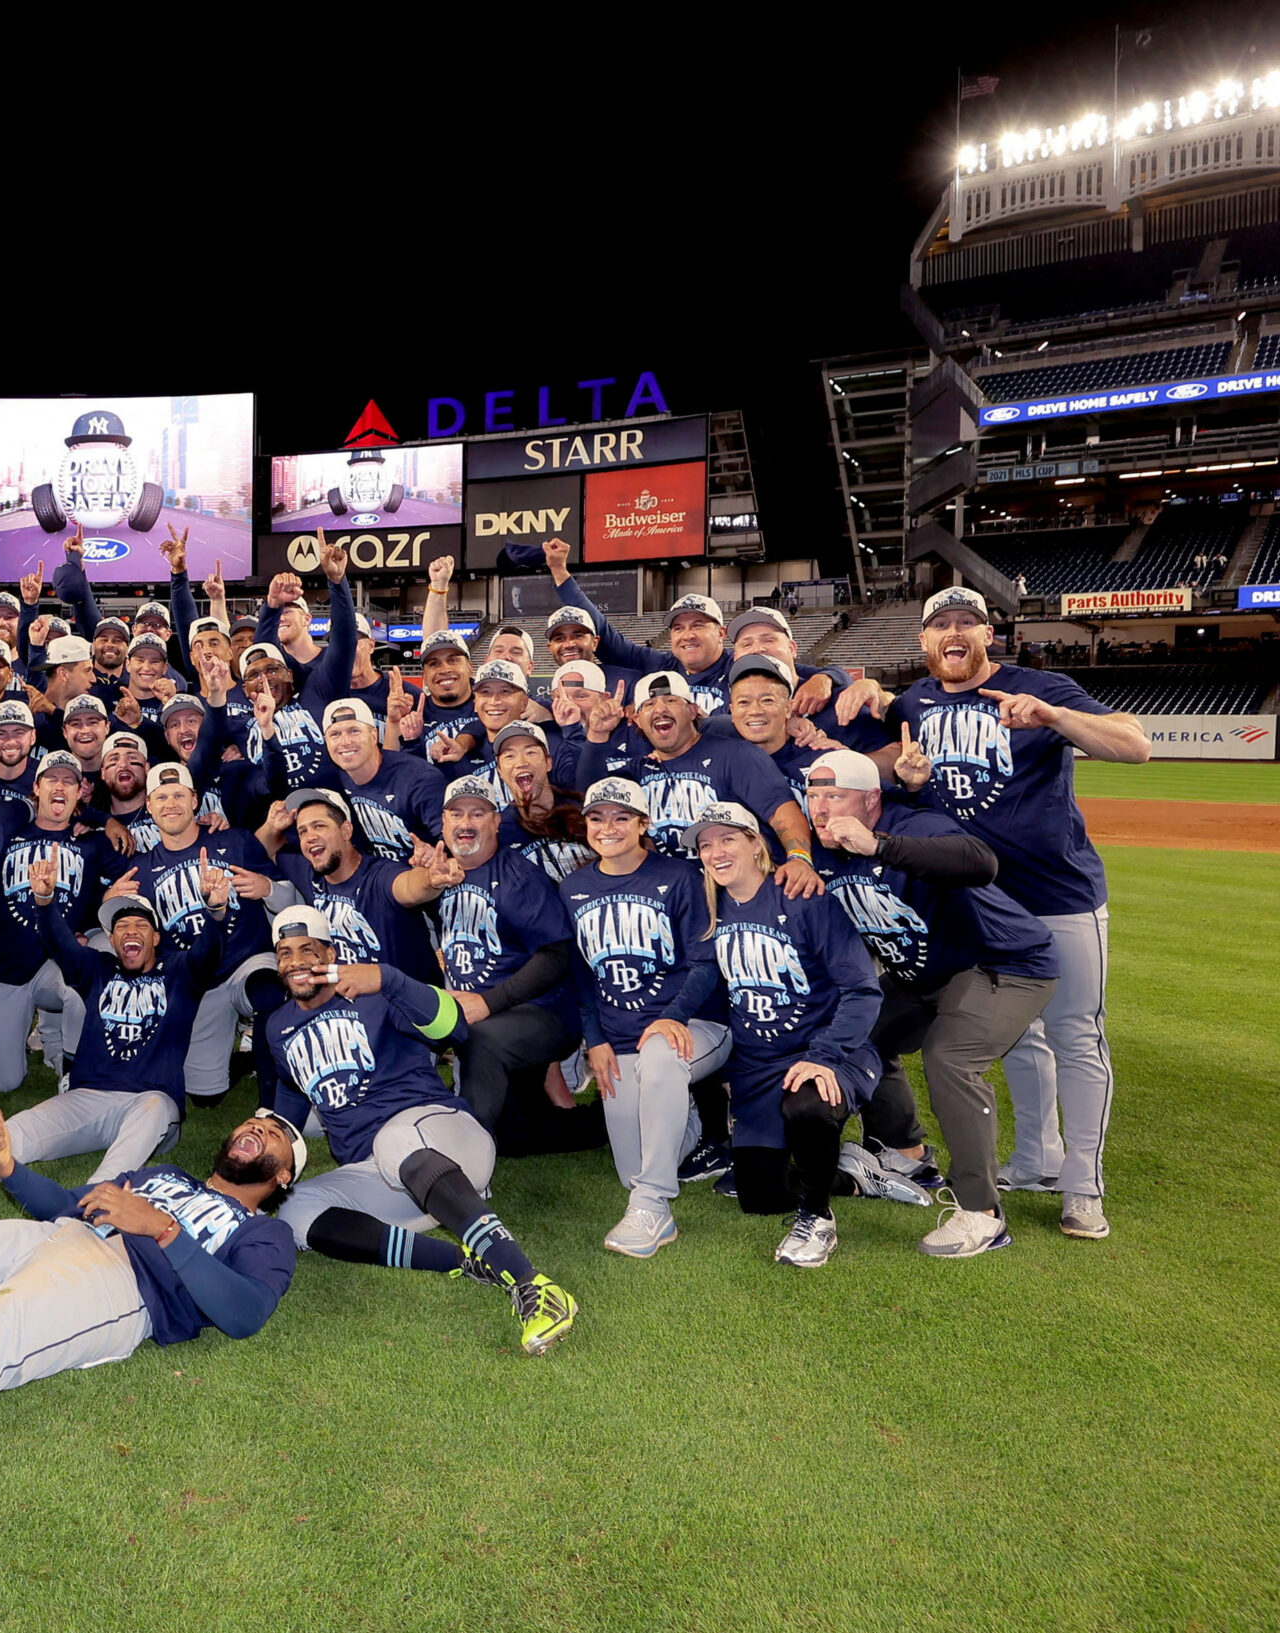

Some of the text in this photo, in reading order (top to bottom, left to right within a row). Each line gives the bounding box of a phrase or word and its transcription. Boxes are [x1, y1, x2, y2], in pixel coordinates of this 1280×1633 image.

[1217, 377, 1263, 393] DRIVE
[427, 371, 669, 439] DELTA
[1027, 402, 1067, 416] DRIVE
[1069, 397, 1107, 411] HOME
[1109, 390, 1158, 407] SAFELY
[87, 416, 109, 435] NY
[523, 429, 644, 471] STARR
[70, 458, 131, 475] DRIVE
[989, 471, 1007, 481] 2021
[1037, 466, 1054, 476] CUP
[71, 476, 132, 493] HOME
[65, 492, 132, 512] SAFELY
[475, 507, 571, 537] DKNY
[604, 511, 687, 528] Budweiser
[602, 525, 684, 540] Made of America
[83, 539, 117, 559] Ford
[933, 599, 979, 612] CHAMPIONS
[1067, 591, 1185, 609] Parts Authority
[480, 671, 514, 682] CHAMPIONS
[920, 710, 1013, 777] CHAMPS
[1145, 731, 1224, 743] MERICA
[301, 744, 312, 756] 26
[451, 787, 489, 798] CHAMPIONS
[941, 766, 990, 799] TB 26
[590, 791, 631, 803] CHAMPIONS
[6, 839, 41, 853] AMERICAN
[153, 862, 185, 885] AMERICAN
[17, 892, 69, 903] 20 26
[573, 894, 667, 920] AMERICAN LEAGUE EAST
[577, 902, 674, 967] CHAMPS
[716, 922, 793, 944] RICAN LEAGUE EAST
[454, 943, 485, 974] TB 26
[873, 934, 912, 964] TB 26
[605, 959, 642, 993] TB
[642, 961, 656, 975] 26
[336, 1010, 360, 1020] EAST
[740, 989, 778, 1022] TB
[774, 992, 790, 1006] 26
[117, 1022, 142, 1045] TB
[286, 1018, 376, 1095] CHAMPS
[319, 1077, 350, 1109] TB
